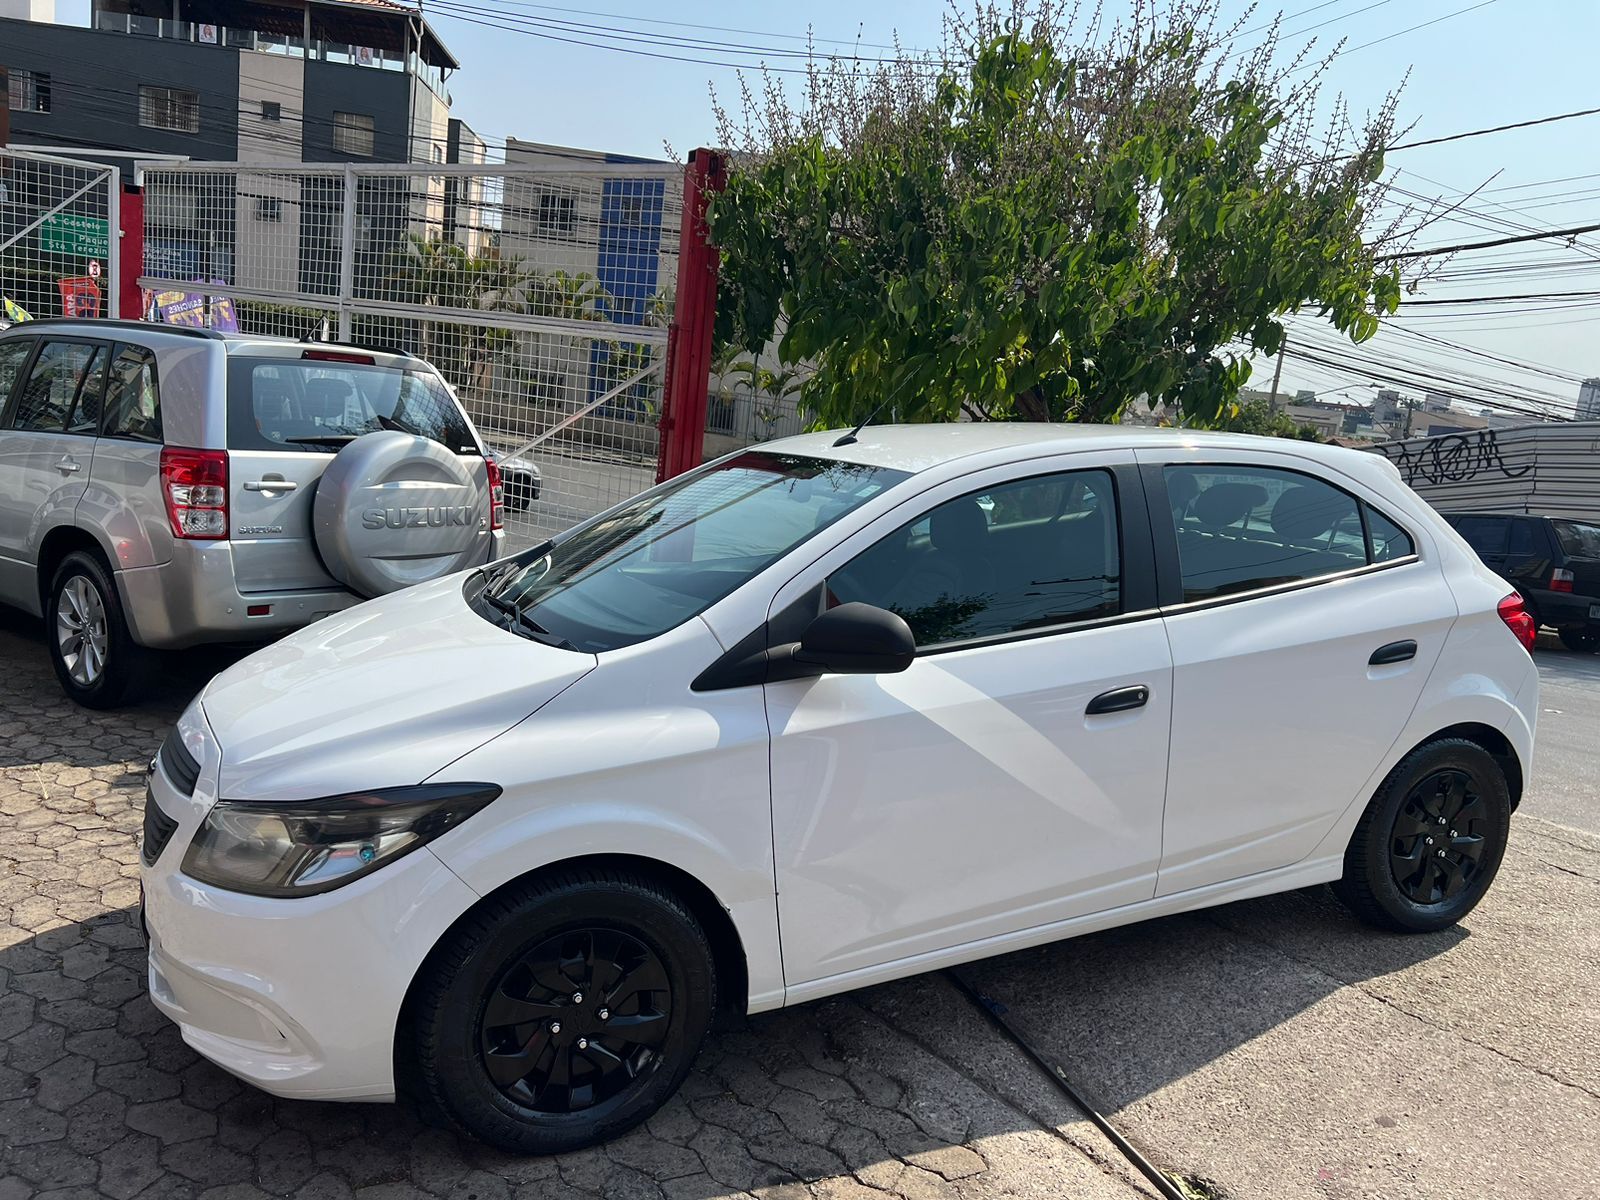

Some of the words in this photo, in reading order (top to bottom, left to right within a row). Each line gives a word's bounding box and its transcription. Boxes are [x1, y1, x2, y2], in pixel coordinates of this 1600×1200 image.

[63, 218, 101, 230] Castelo
[362, 505, 472, 530] SUZUKI
[238, 525, 282, 535] SUZUKI
